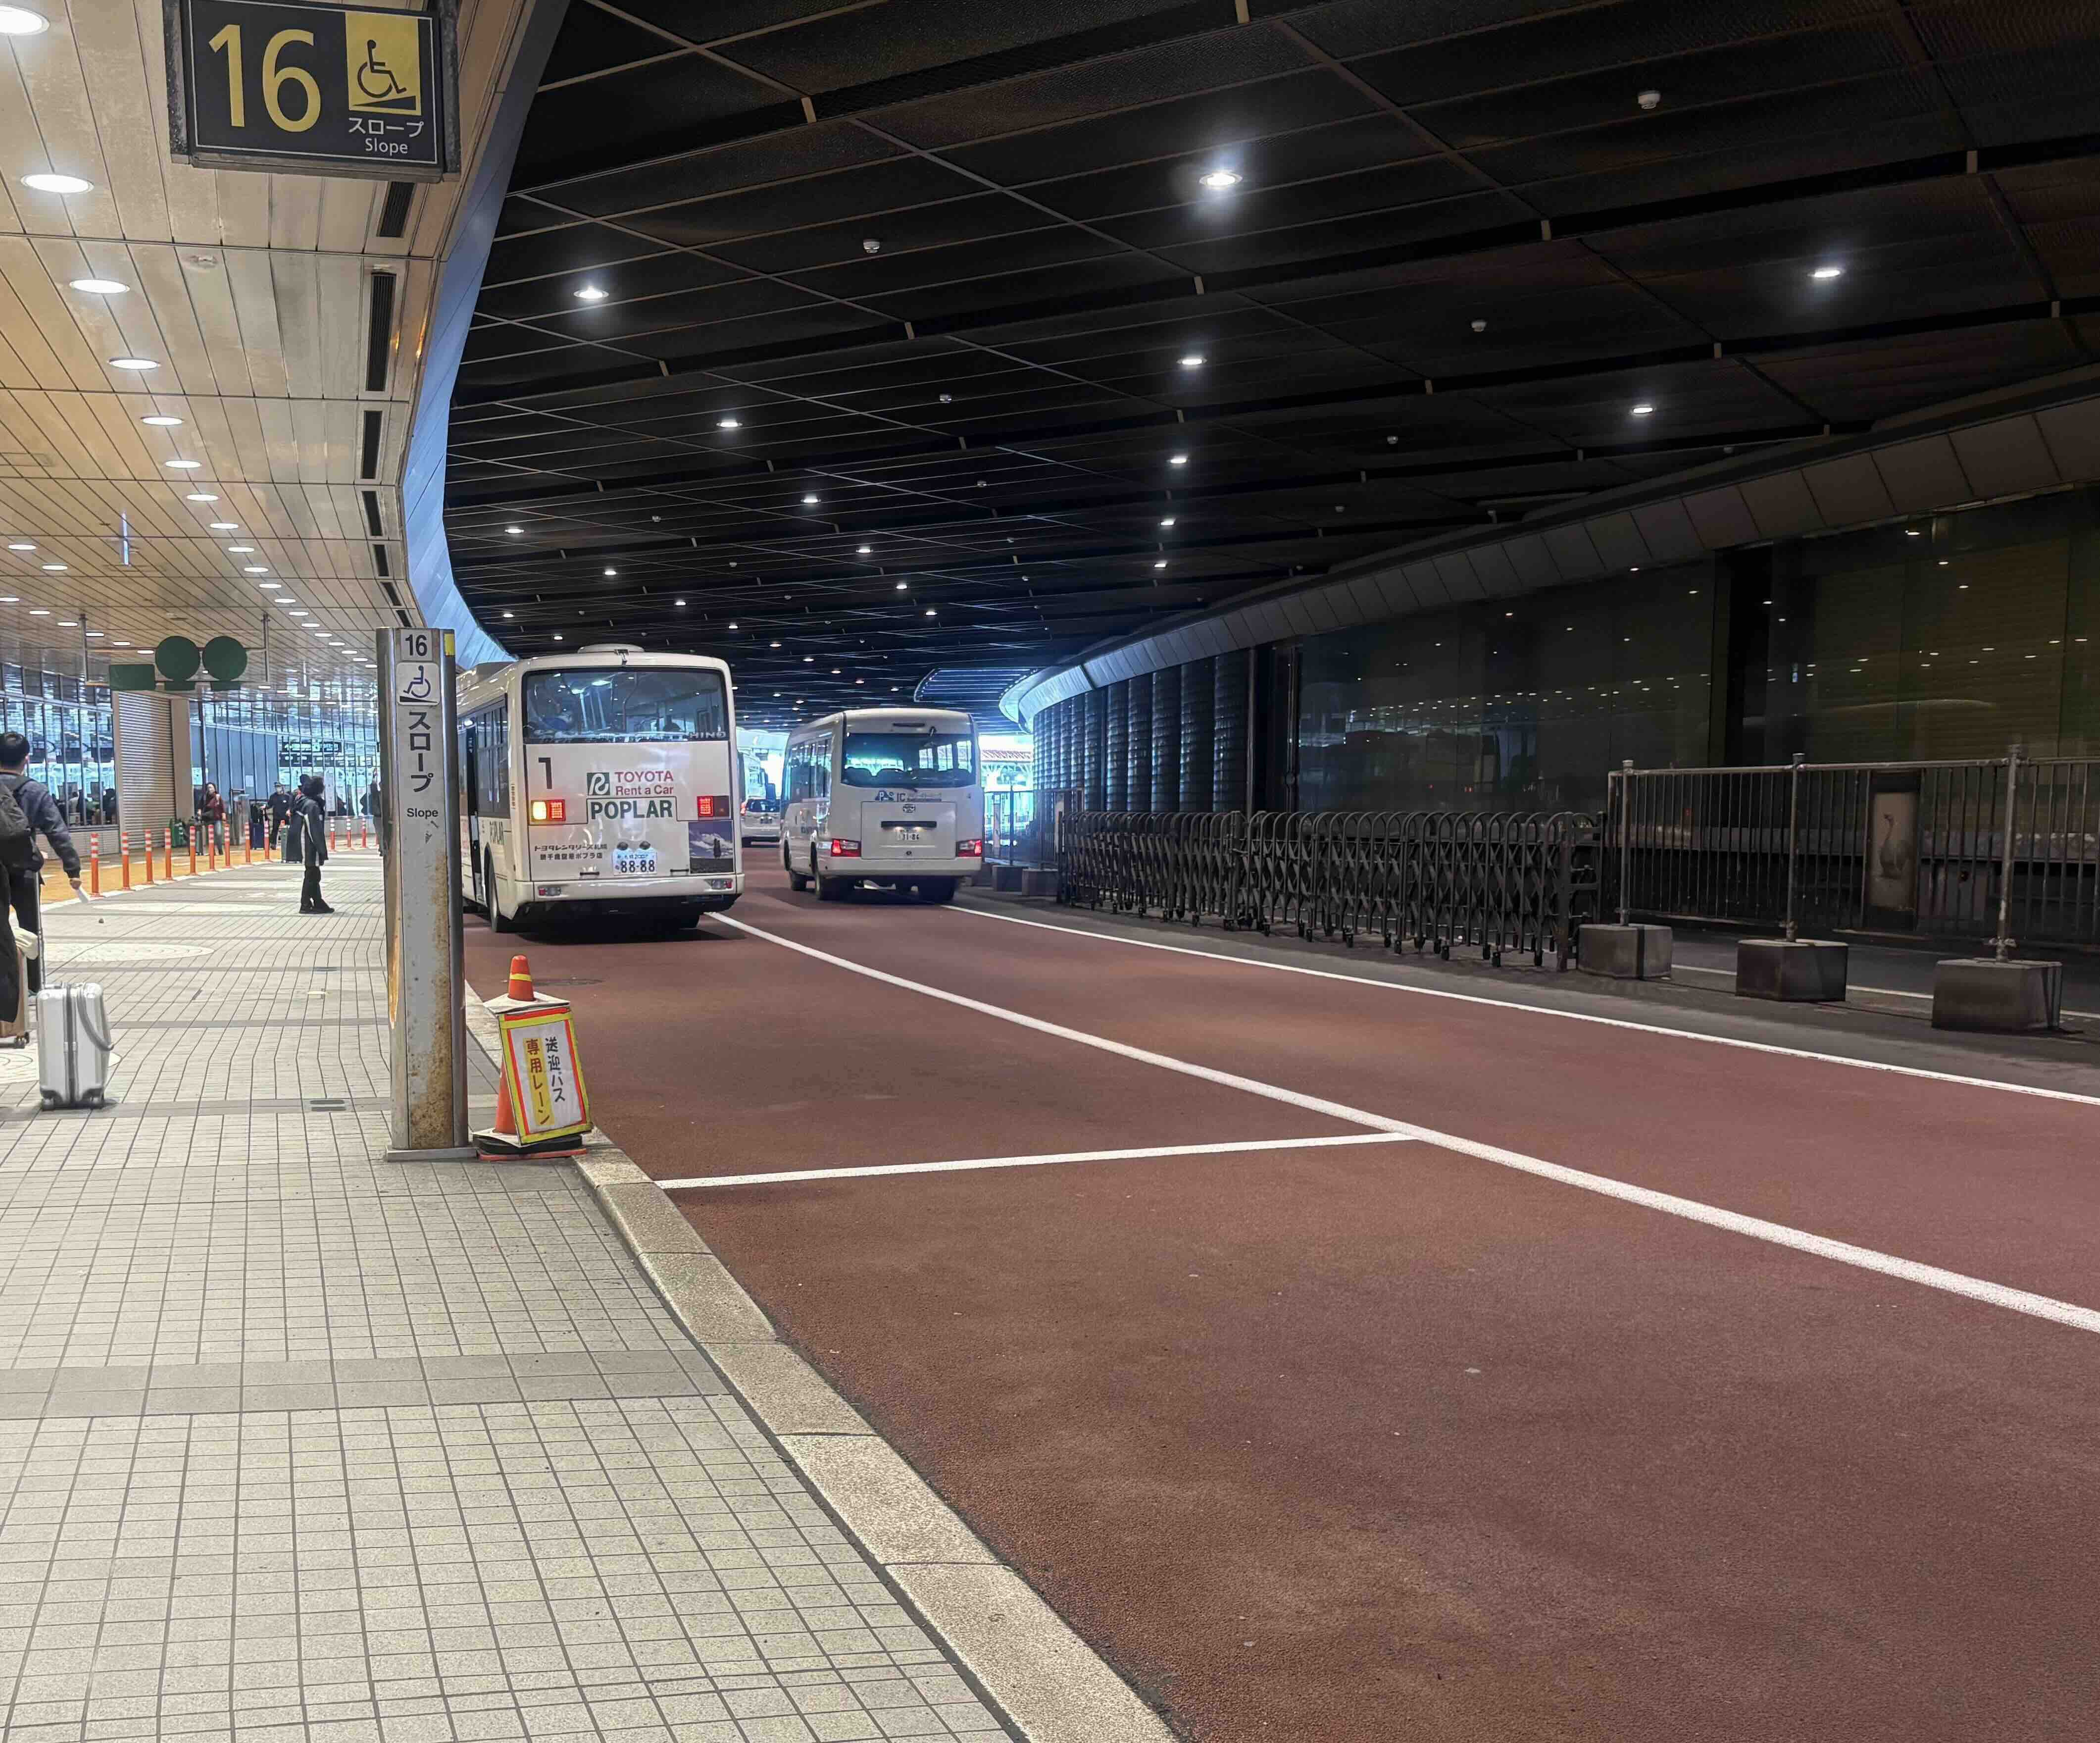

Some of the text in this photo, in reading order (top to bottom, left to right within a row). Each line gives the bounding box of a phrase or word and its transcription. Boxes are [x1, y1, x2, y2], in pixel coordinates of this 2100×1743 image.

[208, 24, 321, 132] 16
[348, 117, 424, 138] スロープ
[365, 138, 408, 155] Slope
[405, 634, 428, 657] 16
[408, 712, 434, 792] スロープ
[615, 771, 673, 783] TOYOTA
[616, 786, 642, 796] Rent
[654, 785, 673, 795] Car
[407, 808, 439, 820] Slope
[591, 800, 672, 820] POPLAR
[621, 860, 654, 872] 88-88
[545, 1036, 565, 1102] 送迎バス
[526, 1038, 550, 1125] 専用レーン
